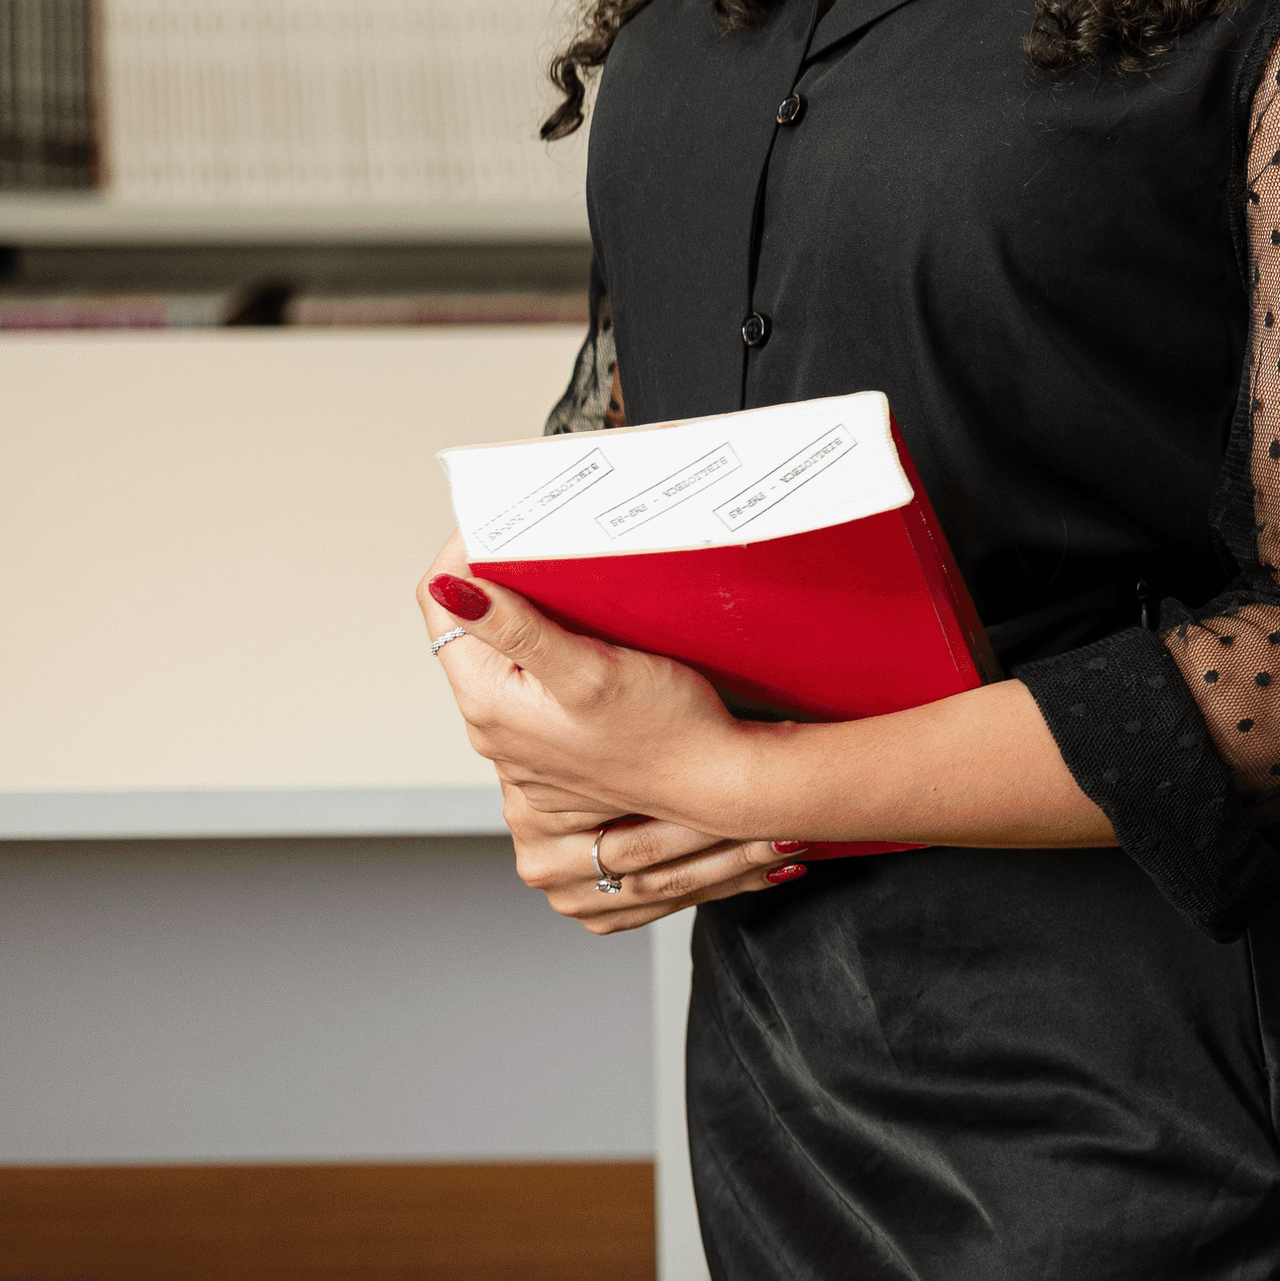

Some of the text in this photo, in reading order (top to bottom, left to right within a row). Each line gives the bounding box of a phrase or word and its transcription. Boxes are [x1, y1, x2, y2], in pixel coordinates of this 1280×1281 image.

[662, 455, 729, 499] BIBLIOTECA
[779, 437, 843, 484] BIBLIOTECA
[536, 462, 600, 507] BIBLIOTECA
